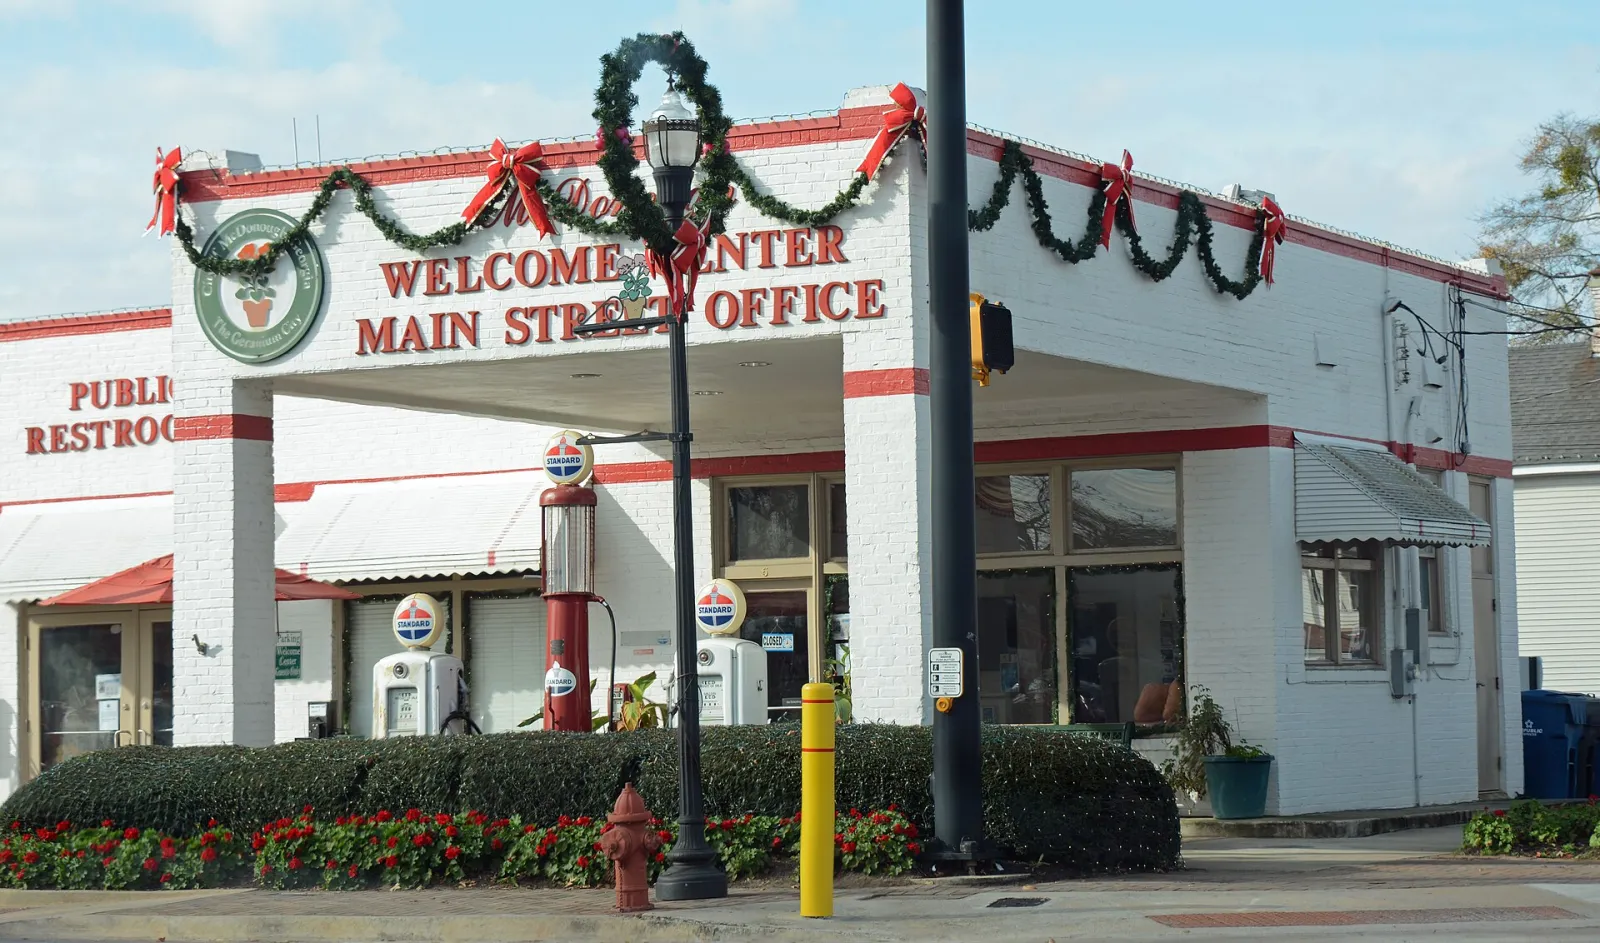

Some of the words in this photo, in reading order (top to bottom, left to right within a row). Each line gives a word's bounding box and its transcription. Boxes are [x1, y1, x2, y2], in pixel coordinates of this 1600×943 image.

[379, 244, 621, 298] WELCOME
[698, 225, 848, 274] NTER
[212, 315, 231, 339] The
[230, 331, 284, 349] Geranium
[281, 314, 303, 336] City
[355, 311, 480, 356] MAIN
[704, 279, 885, 329] OFFICE
[69, 375, 174, 411] PUBLI
[25, 414, 175, 455] RESTROO
[546, 456, 581, 465] STANDARD
[397, 620, 430, 628] STANDARD
[698, 605, 733, 614] STANDARD
[763, 635, 783, 646] CLOSED
